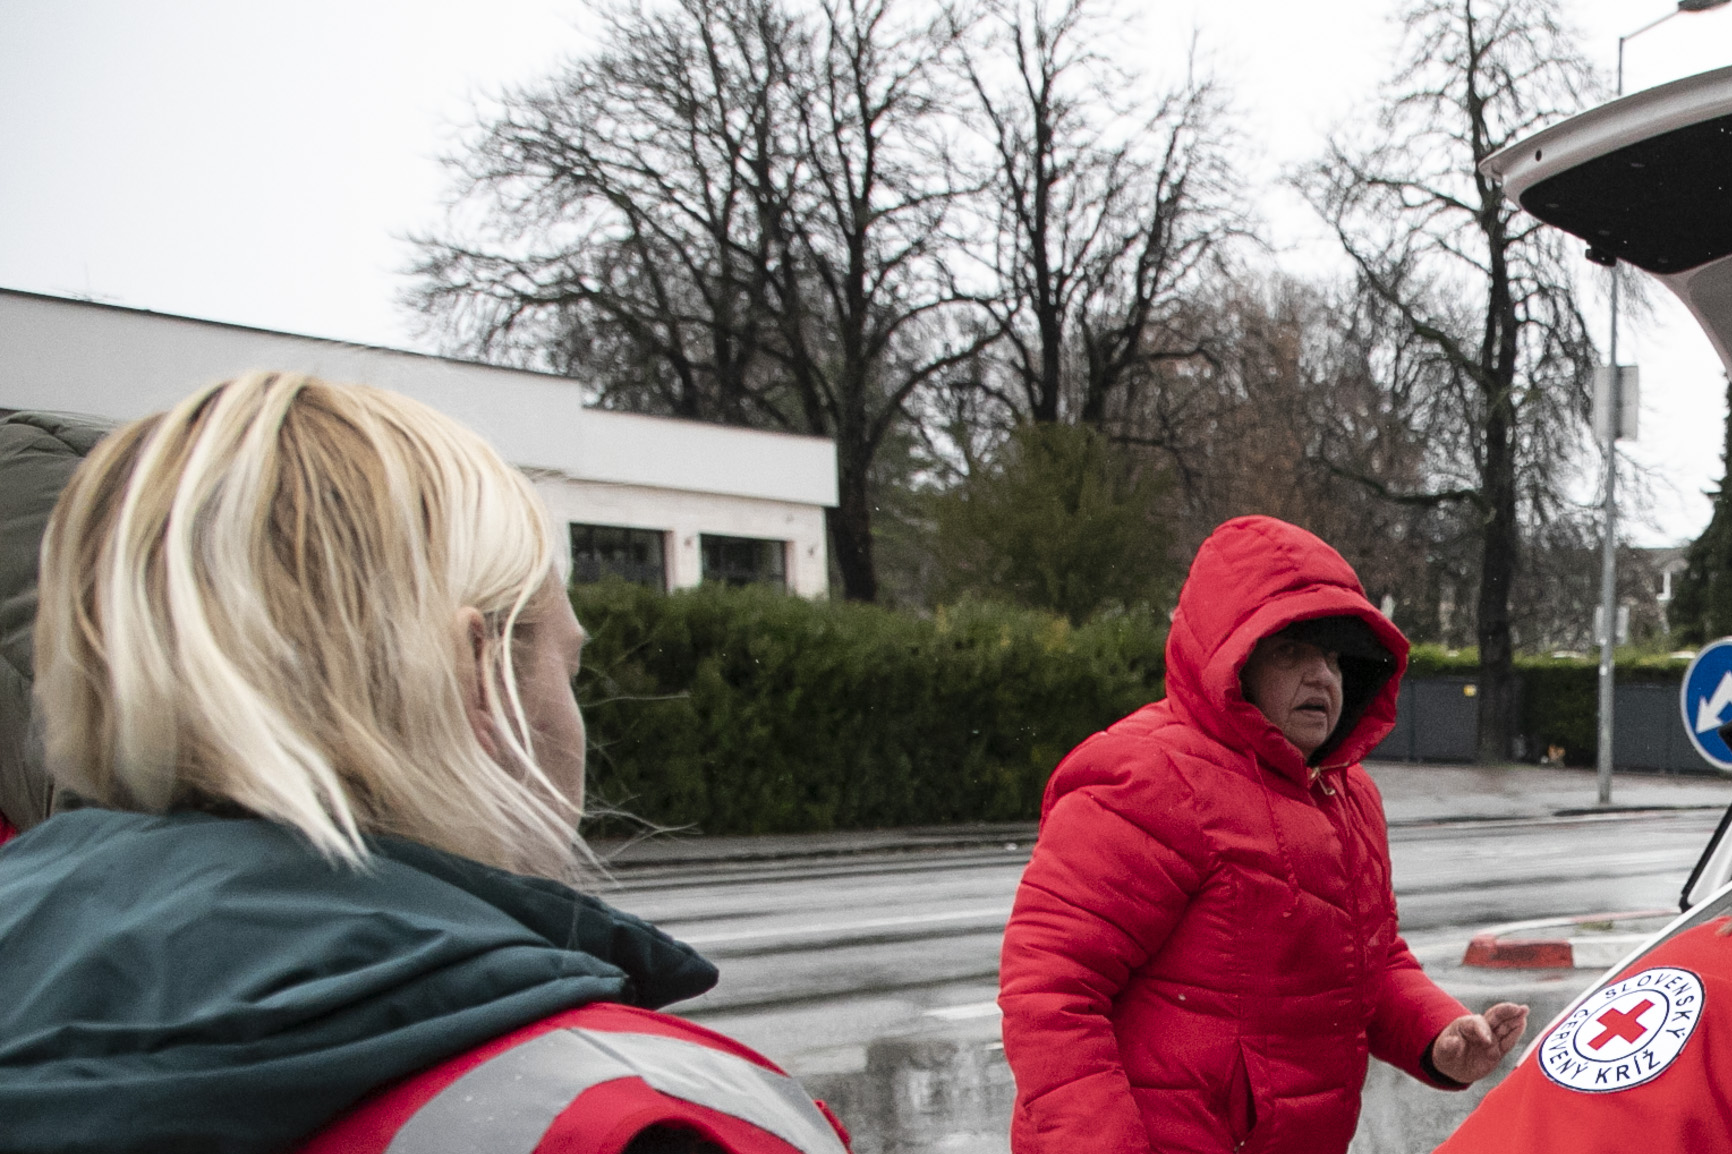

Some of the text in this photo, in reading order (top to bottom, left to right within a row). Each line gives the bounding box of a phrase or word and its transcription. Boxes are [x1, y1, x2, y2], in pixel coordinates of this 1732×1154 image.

[1605, 973, 1695, 1040] SLOVENSKÝ
[1549, 1008, 1661, 1084] ČERVENÝ KRÍŽ
